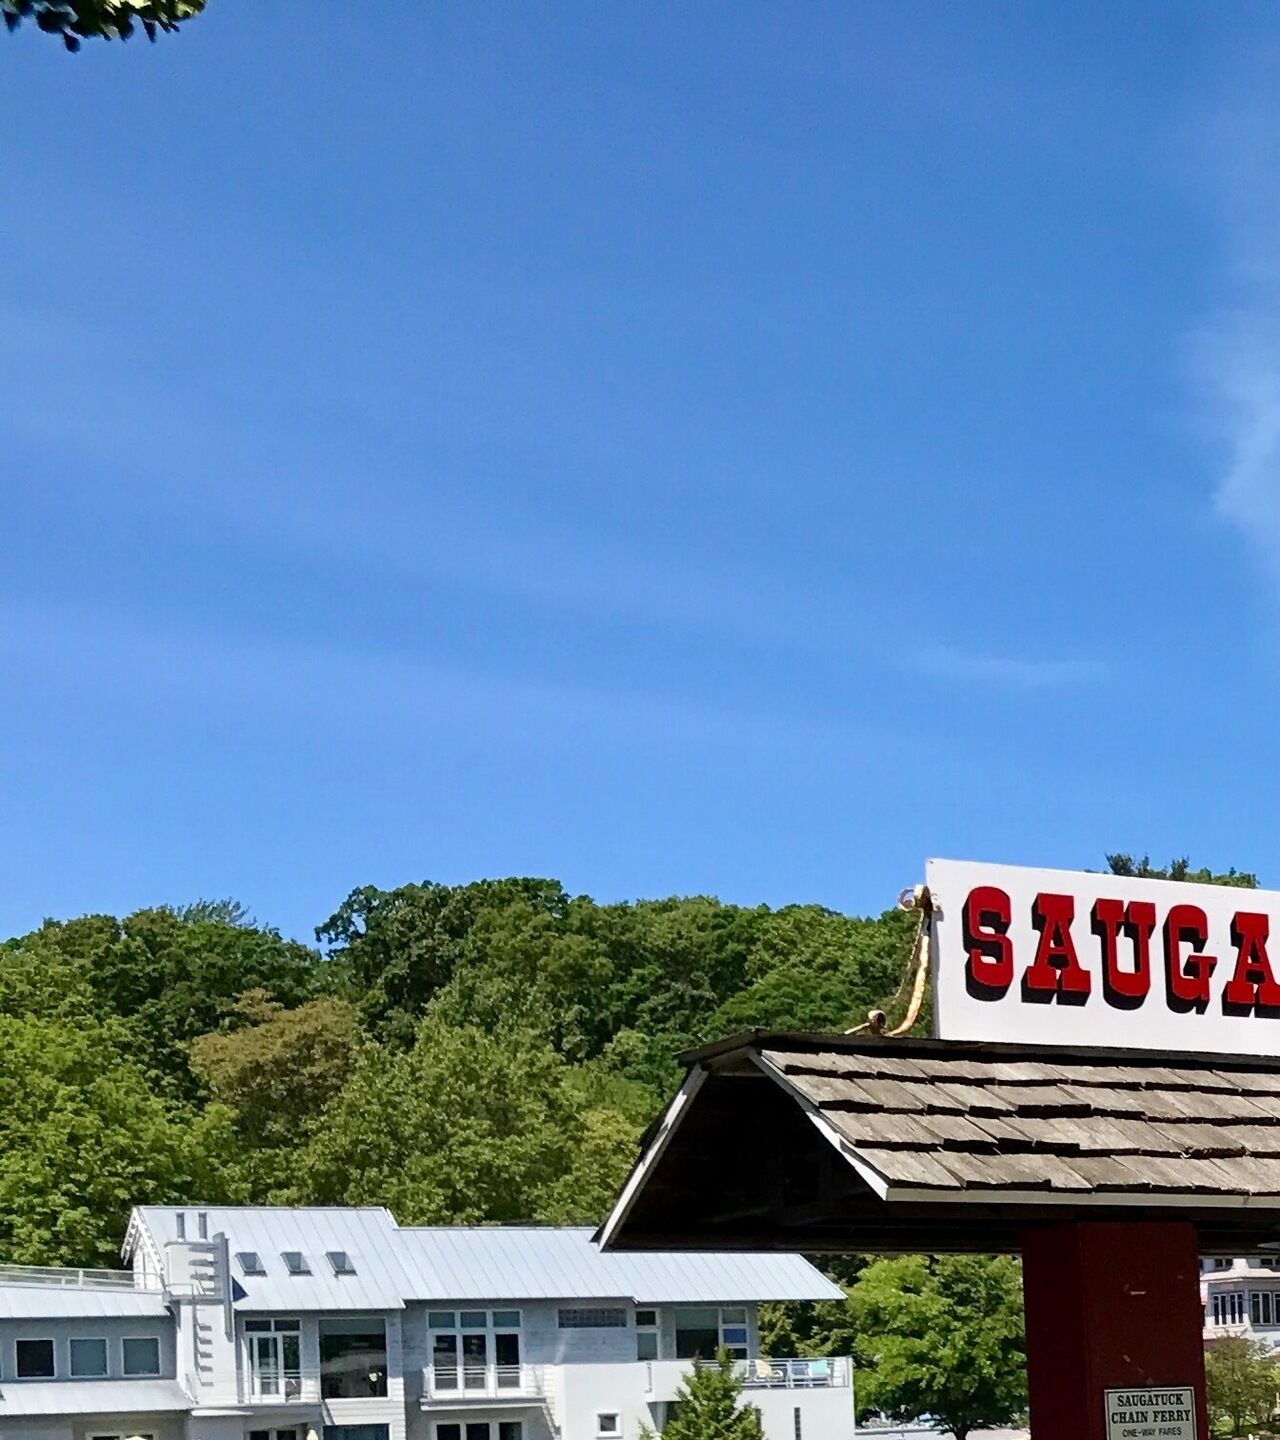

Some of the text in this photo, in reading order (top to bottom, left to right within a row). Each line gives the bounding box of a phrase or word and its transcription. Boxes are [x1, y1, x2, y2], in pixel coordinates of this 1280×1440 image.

[1117, 1393, 1184, 1407] SAUGATUCK
[1111, 1410, 1191, 1424] CHAIN FERRY
[1122, 1427, 1182, 1438] ONE-WAY FARES
